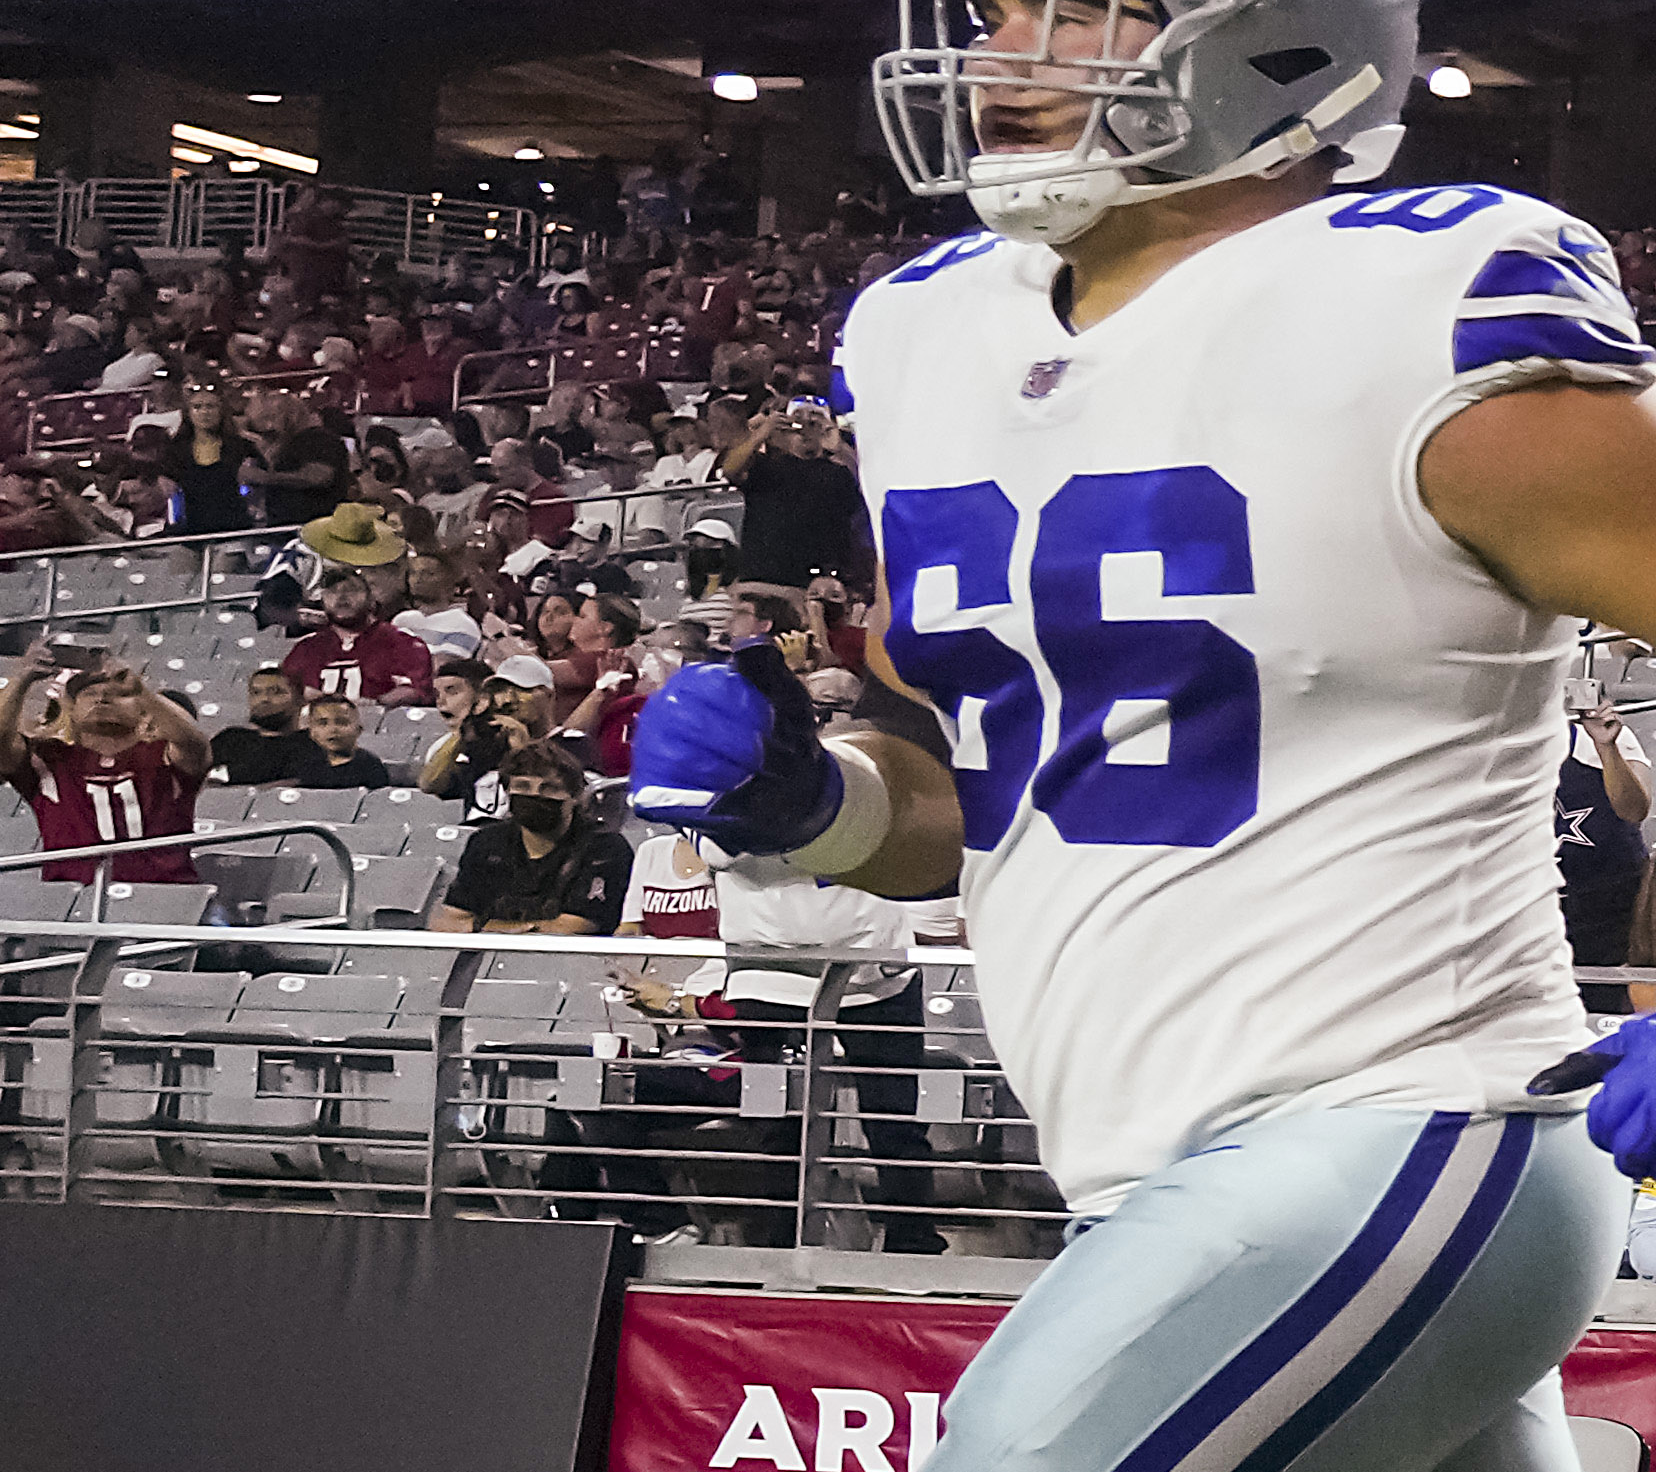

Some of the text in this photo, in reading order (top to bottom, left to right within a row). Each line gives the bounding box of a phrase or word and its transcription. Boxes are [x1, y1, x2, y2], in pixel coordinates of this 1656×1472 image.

[883, 465, 1261, 850] 66
[320, 666, 363, 701] 11
[86, 779, 143, 842] 11
[642, 889, 718, 915] ARIZONA
